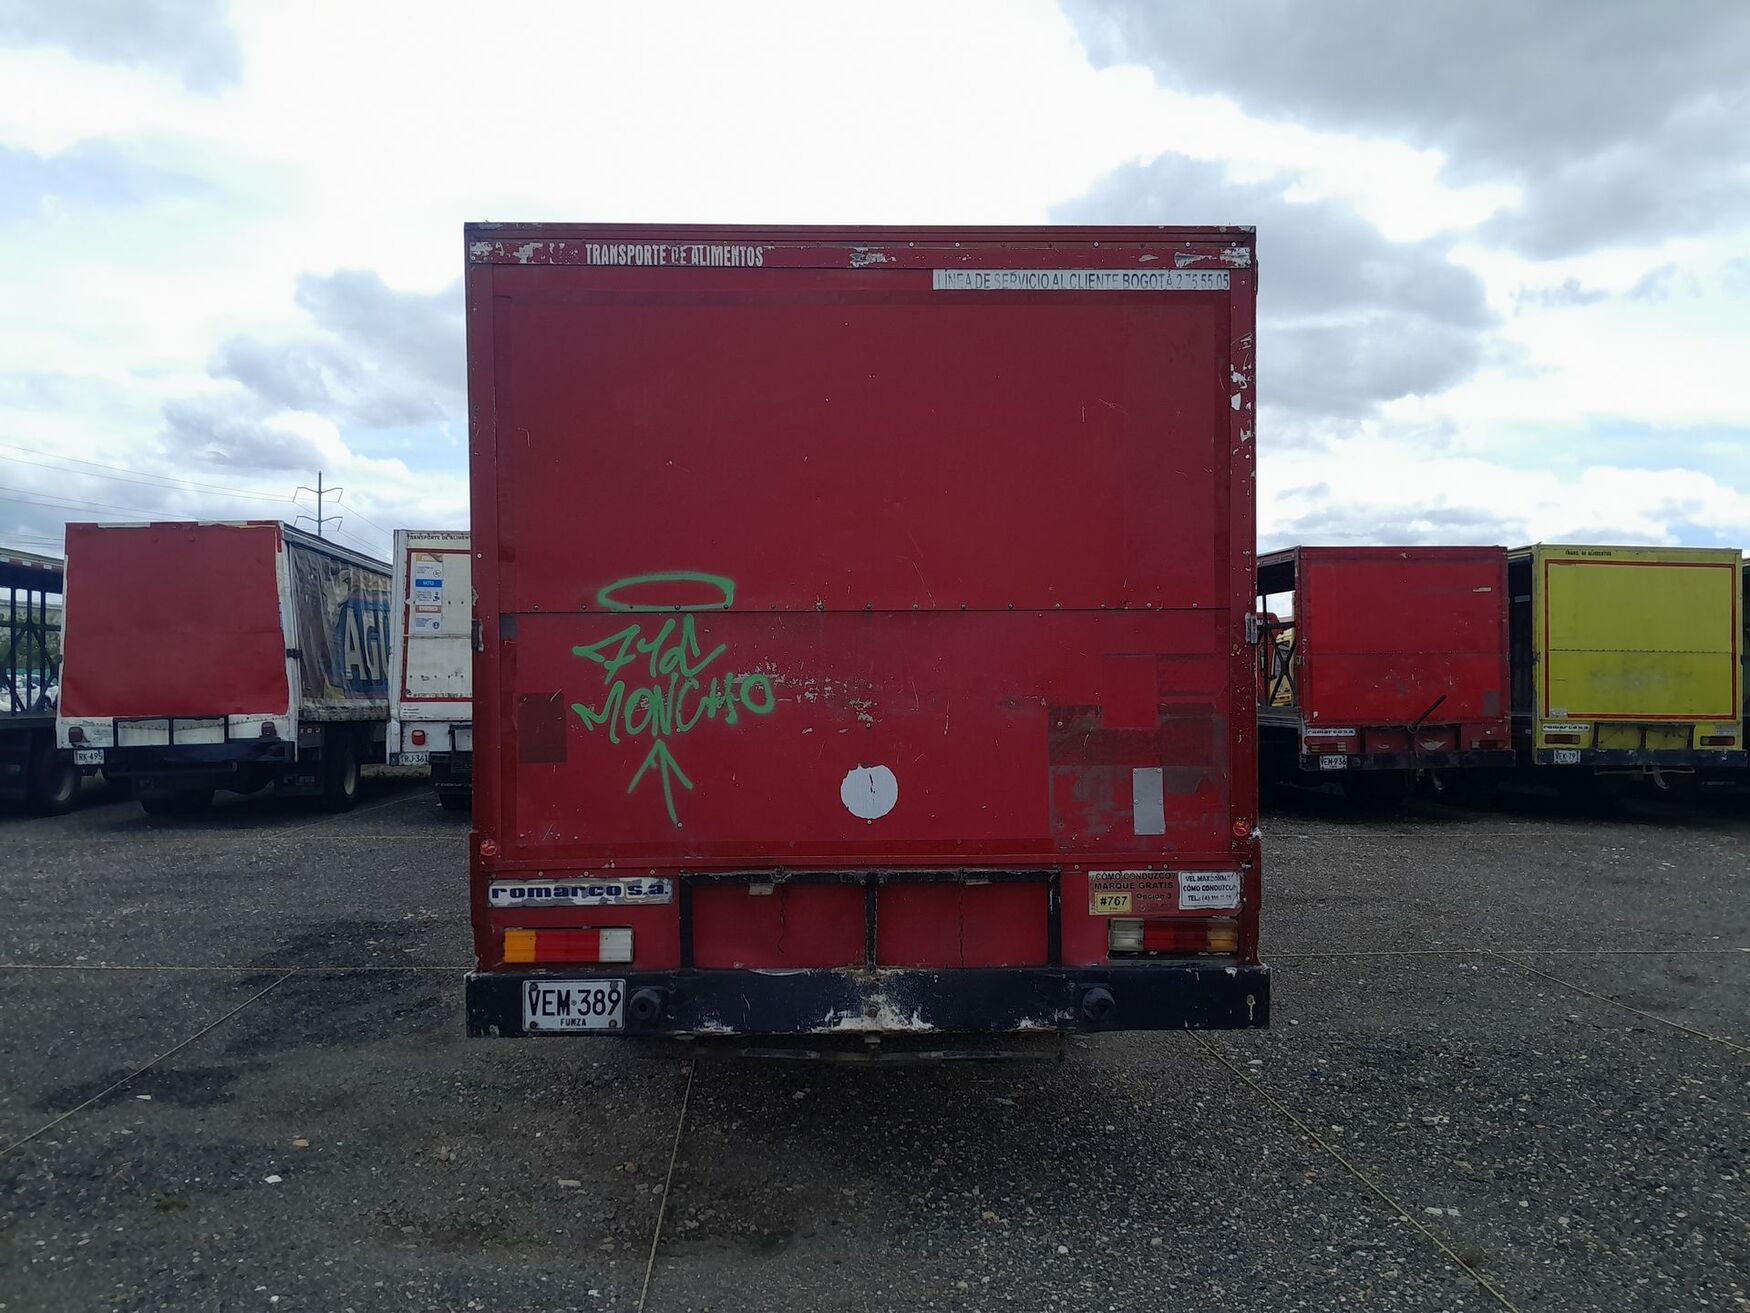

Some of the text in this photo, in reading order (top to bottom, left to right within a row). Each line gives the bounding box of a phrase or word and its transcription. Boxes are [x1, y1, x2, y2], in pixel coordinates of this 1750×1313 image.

[585, 243, 764, 267] TRANSPORTE DE ALIMENTOS
[975, 273, 991, 288] DE
[994, 272, 1049, 288] SERVICIO
[1052, 273, 1068, 288] AL
[1069, 273, 1119, 288] CLIENTE
[1094, 881, 1174, 890] MARQUE GRATIS
[491, 885, 622, 899] romarco
[1100, 896, 1128, 906] #767
[560, 1018, 587, 1027] FUNZA
